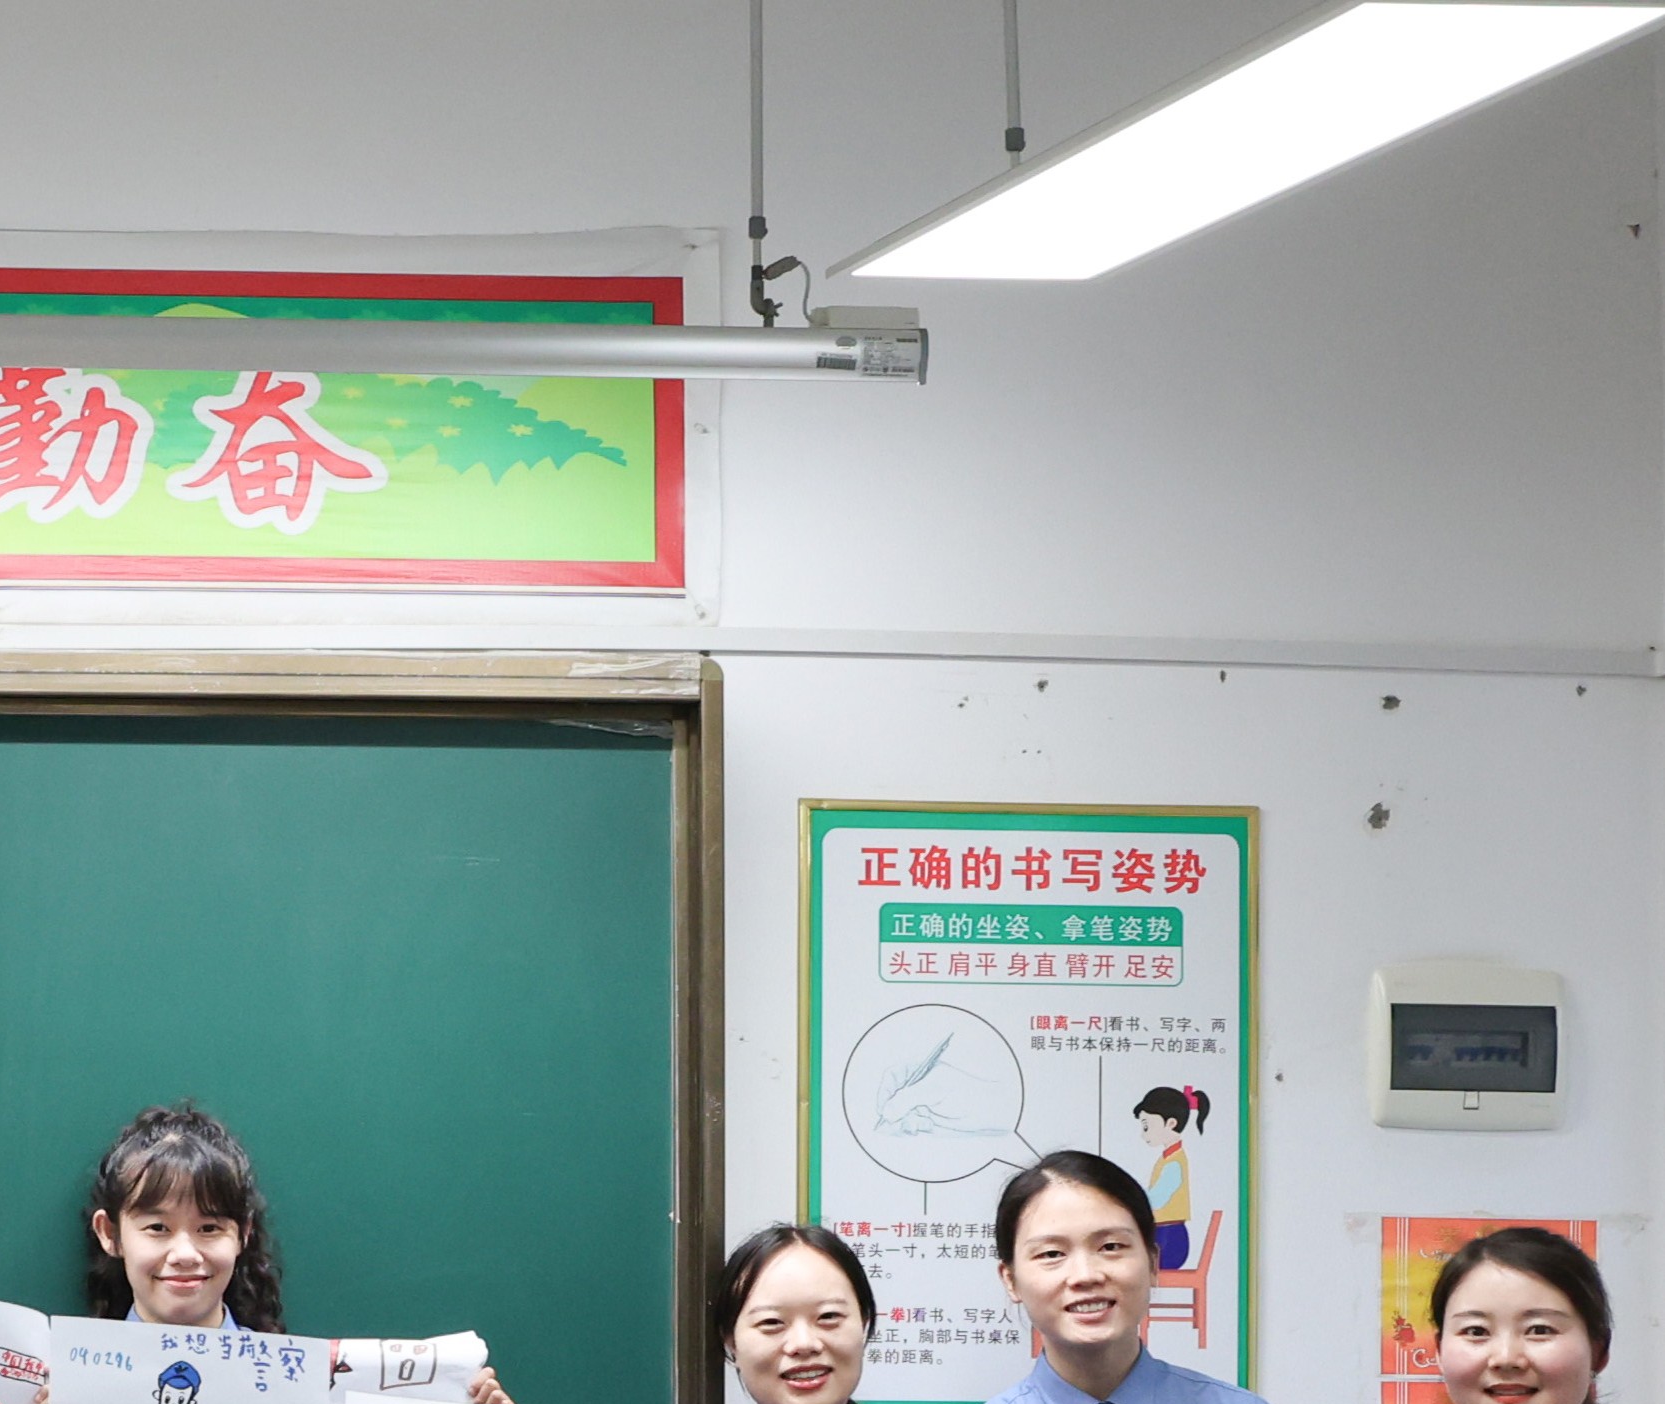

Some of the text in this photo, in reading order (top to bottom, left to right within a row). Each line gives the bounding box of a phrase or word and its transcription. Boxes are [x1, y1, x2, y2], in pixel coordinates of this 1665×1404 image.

[858, 845, 1207, 894] 正确的书写姿势
[891, 912, 1174, 942] 正确的坐姿、拿笔姿势
[889, 951, 1175, 979] 头正 肩平 身直 臂开 足安
[1031, 1035, 1227, 1055] 眼与书本保持一尺的距离。
